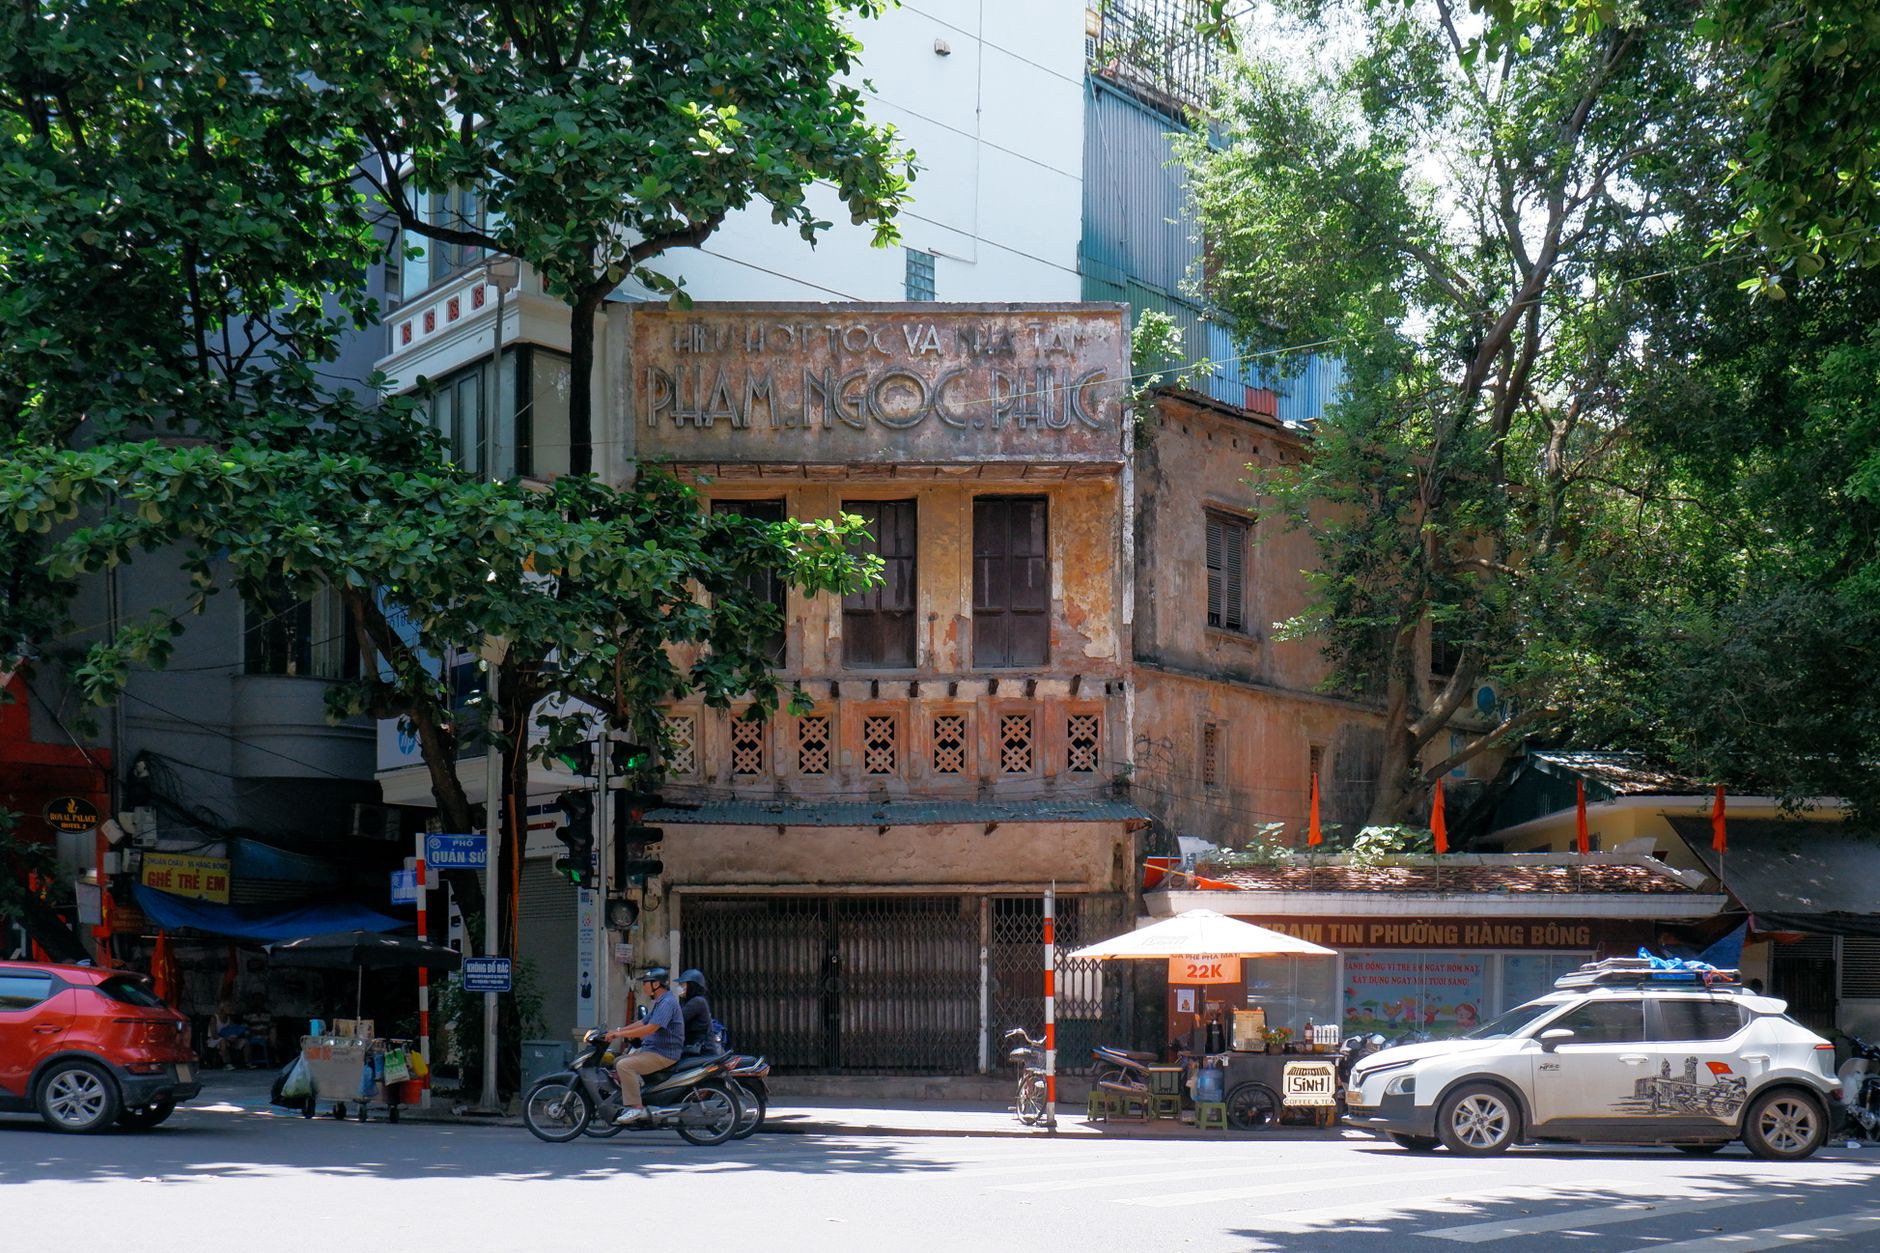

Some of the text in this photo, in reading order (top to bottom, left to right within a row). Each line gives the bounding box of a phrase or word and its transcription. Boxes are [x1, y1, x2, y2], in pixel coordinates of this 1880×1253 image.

[50, 812, 96, 823] ROYAL PALACE
[432, 849, 465, 863] QUÁN
[148, 867, 225, 891] GHẾ TRẺ EM
[1328, 923, 1363, 943] TIN
[1465, 920, 1524, 945] HÀNG
[1530, 921, 1591, 945] BÔNG
[1187, 964, 1222, 978] 22K
